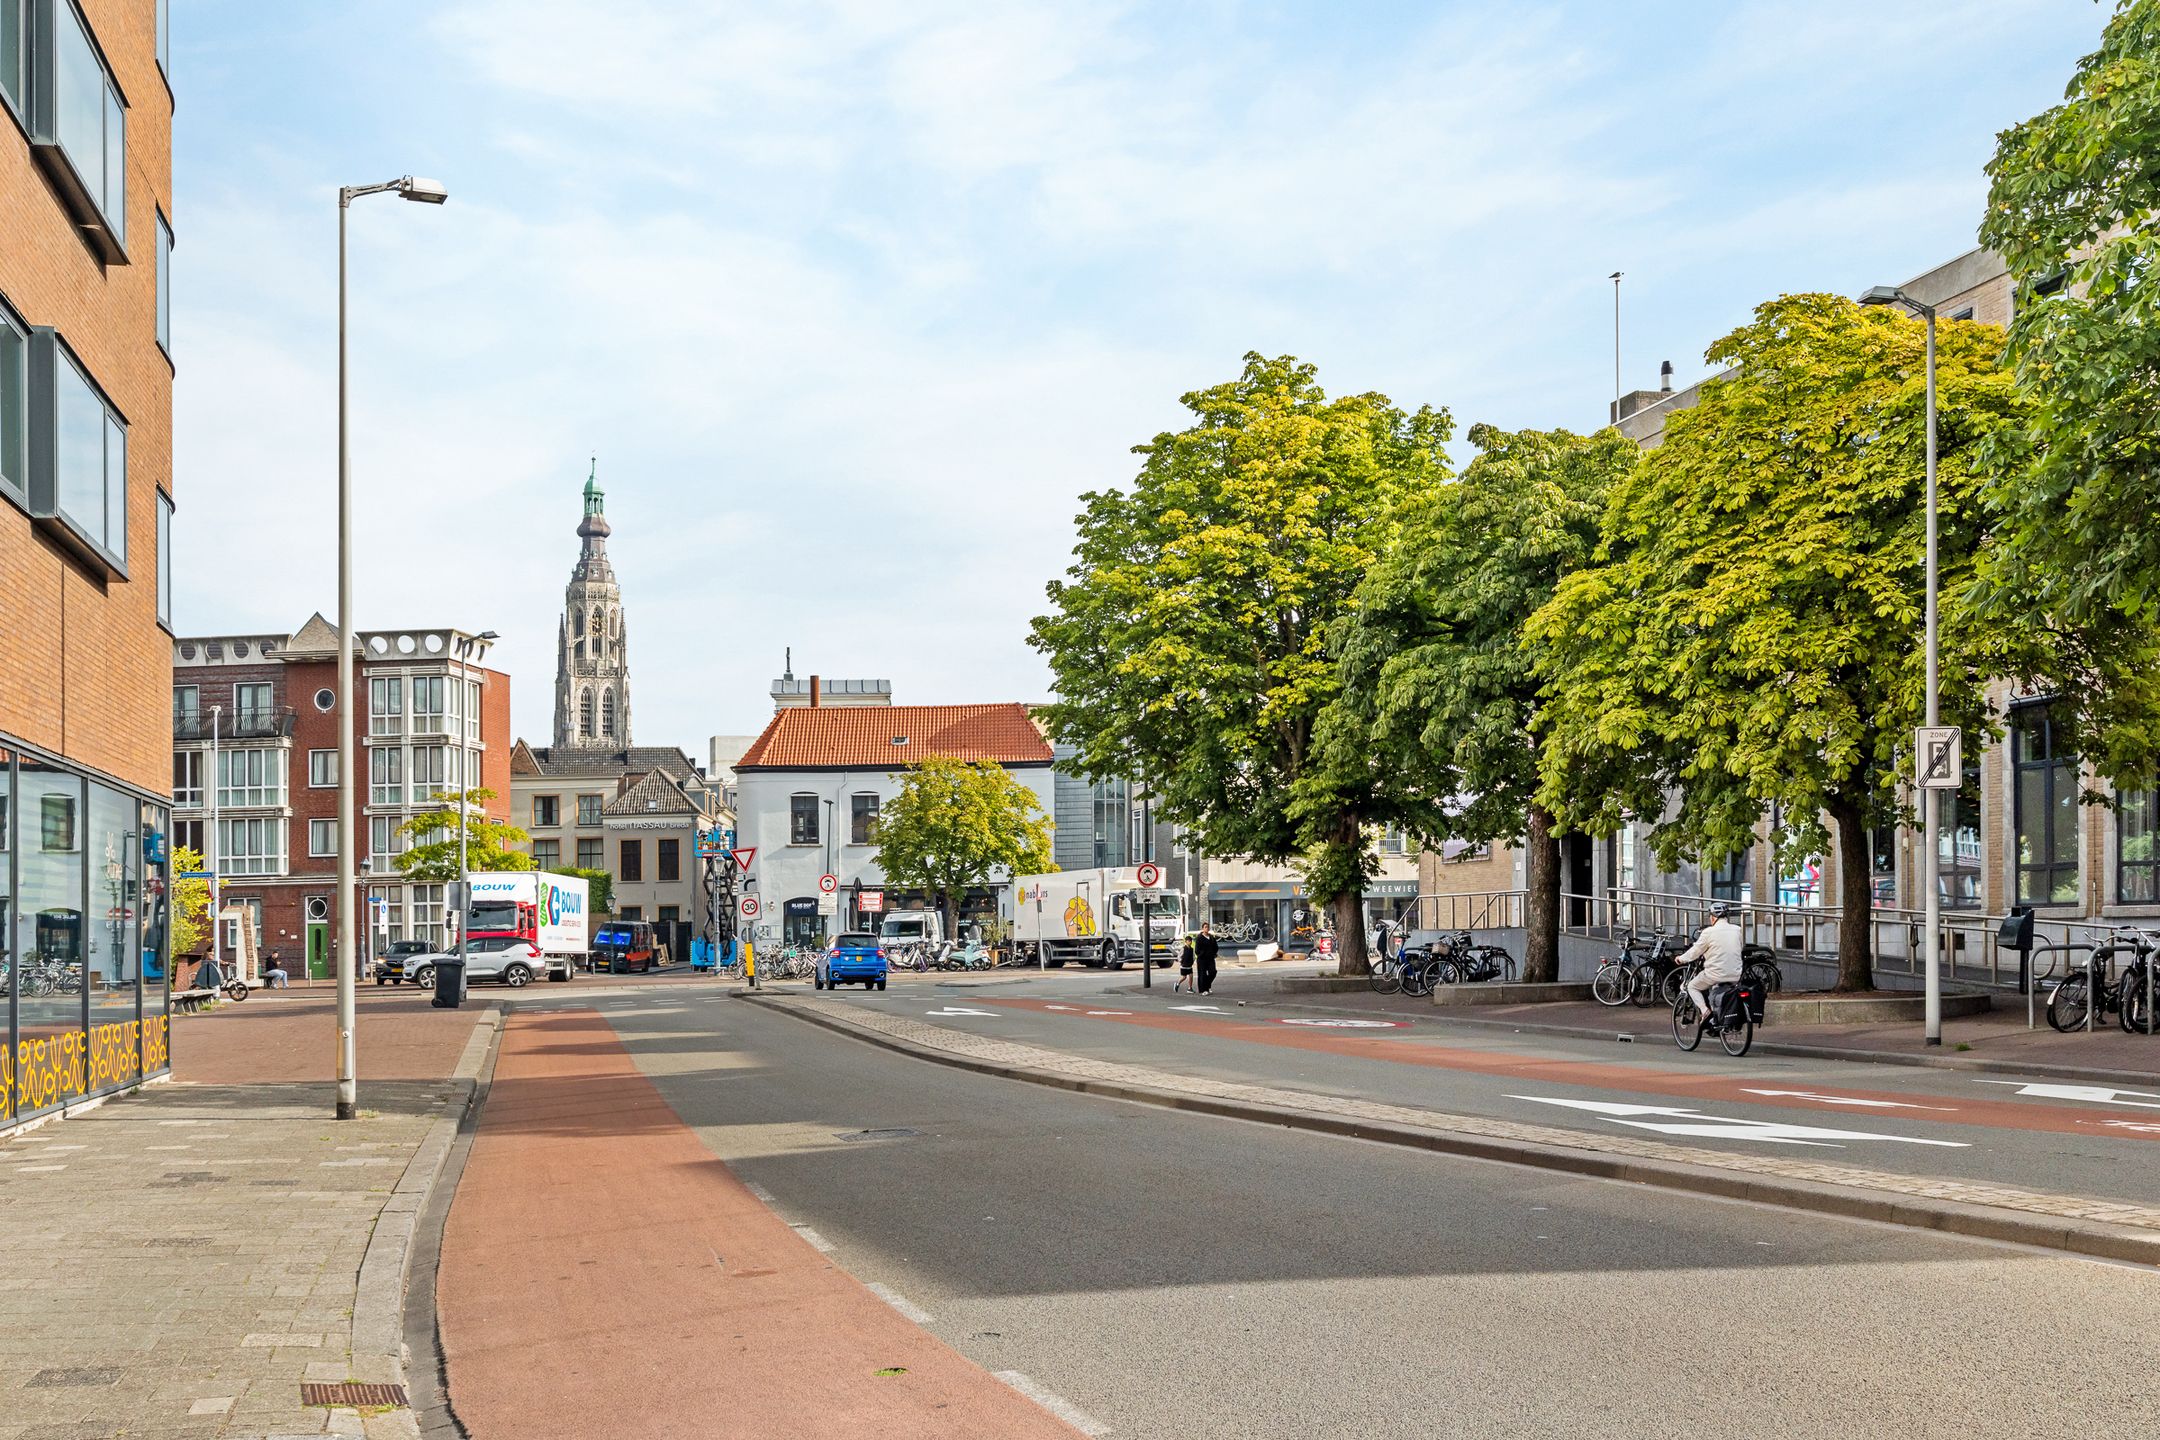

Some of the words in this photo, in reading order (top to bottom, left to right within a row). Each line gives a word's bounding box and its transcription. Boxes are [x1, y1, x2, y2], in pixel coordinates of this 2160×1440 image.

[609, 822, 628, 830] hotel
[562, 891, 581, 914] BOUW
[744, 903, 755, 911] 30
